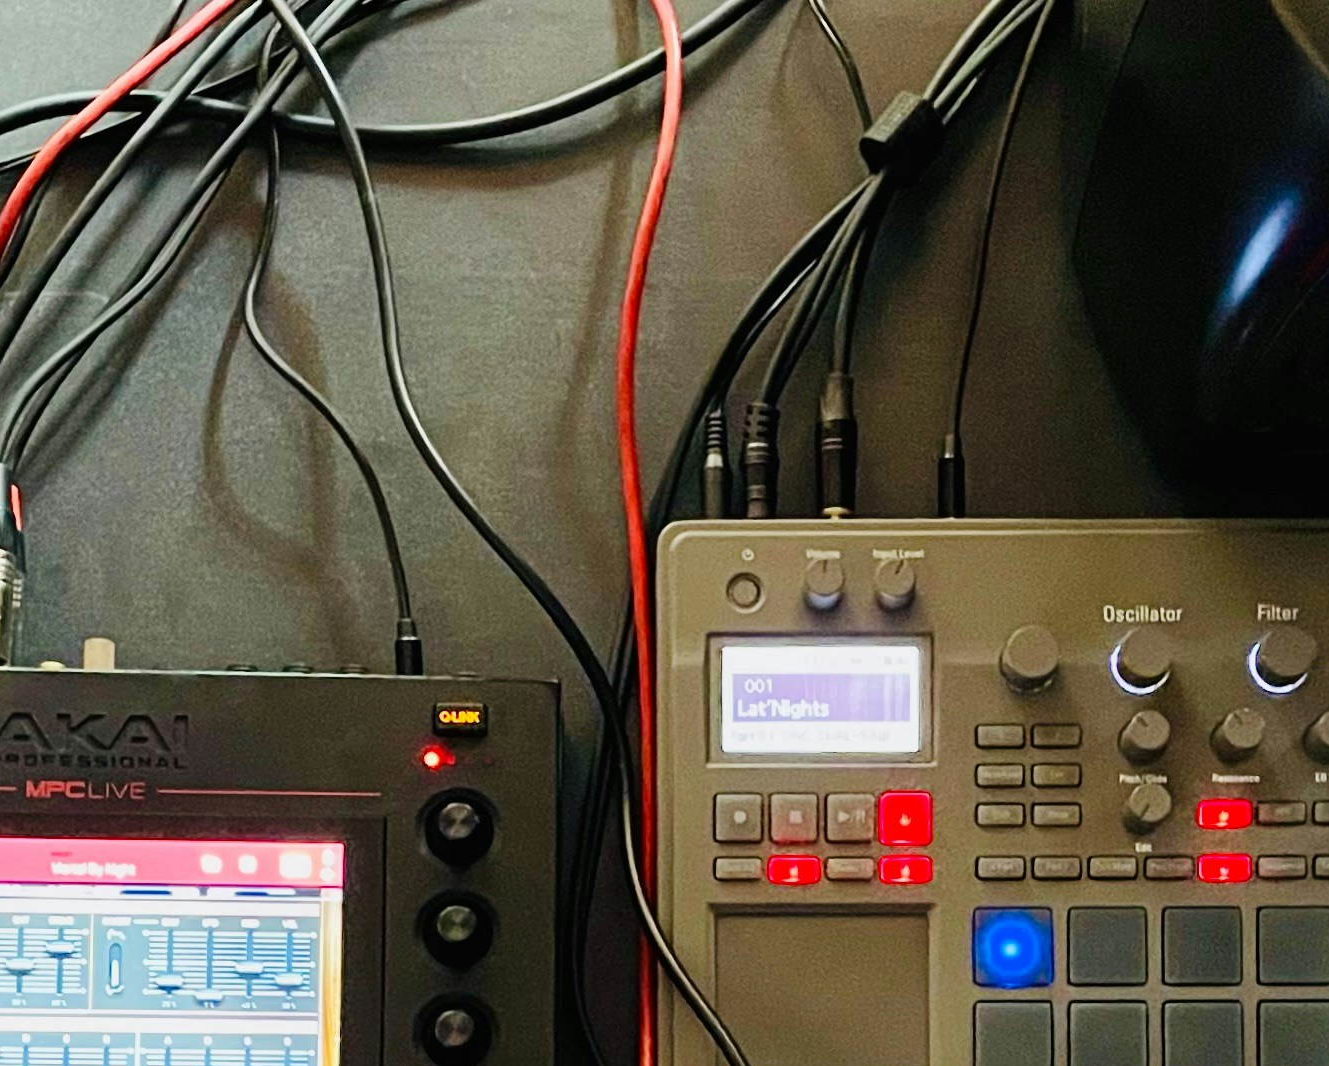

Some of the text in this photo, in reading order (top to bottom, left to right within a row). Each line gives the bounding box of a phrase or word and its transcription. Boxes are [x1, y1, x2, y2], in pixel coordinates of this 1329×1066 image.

[899, 549, 925, 560] Level
[1102, 604, 1183, 623] Oscillator
[1257, 604, 1299, 621] Filter
[744, 678, 773, 694] 001
